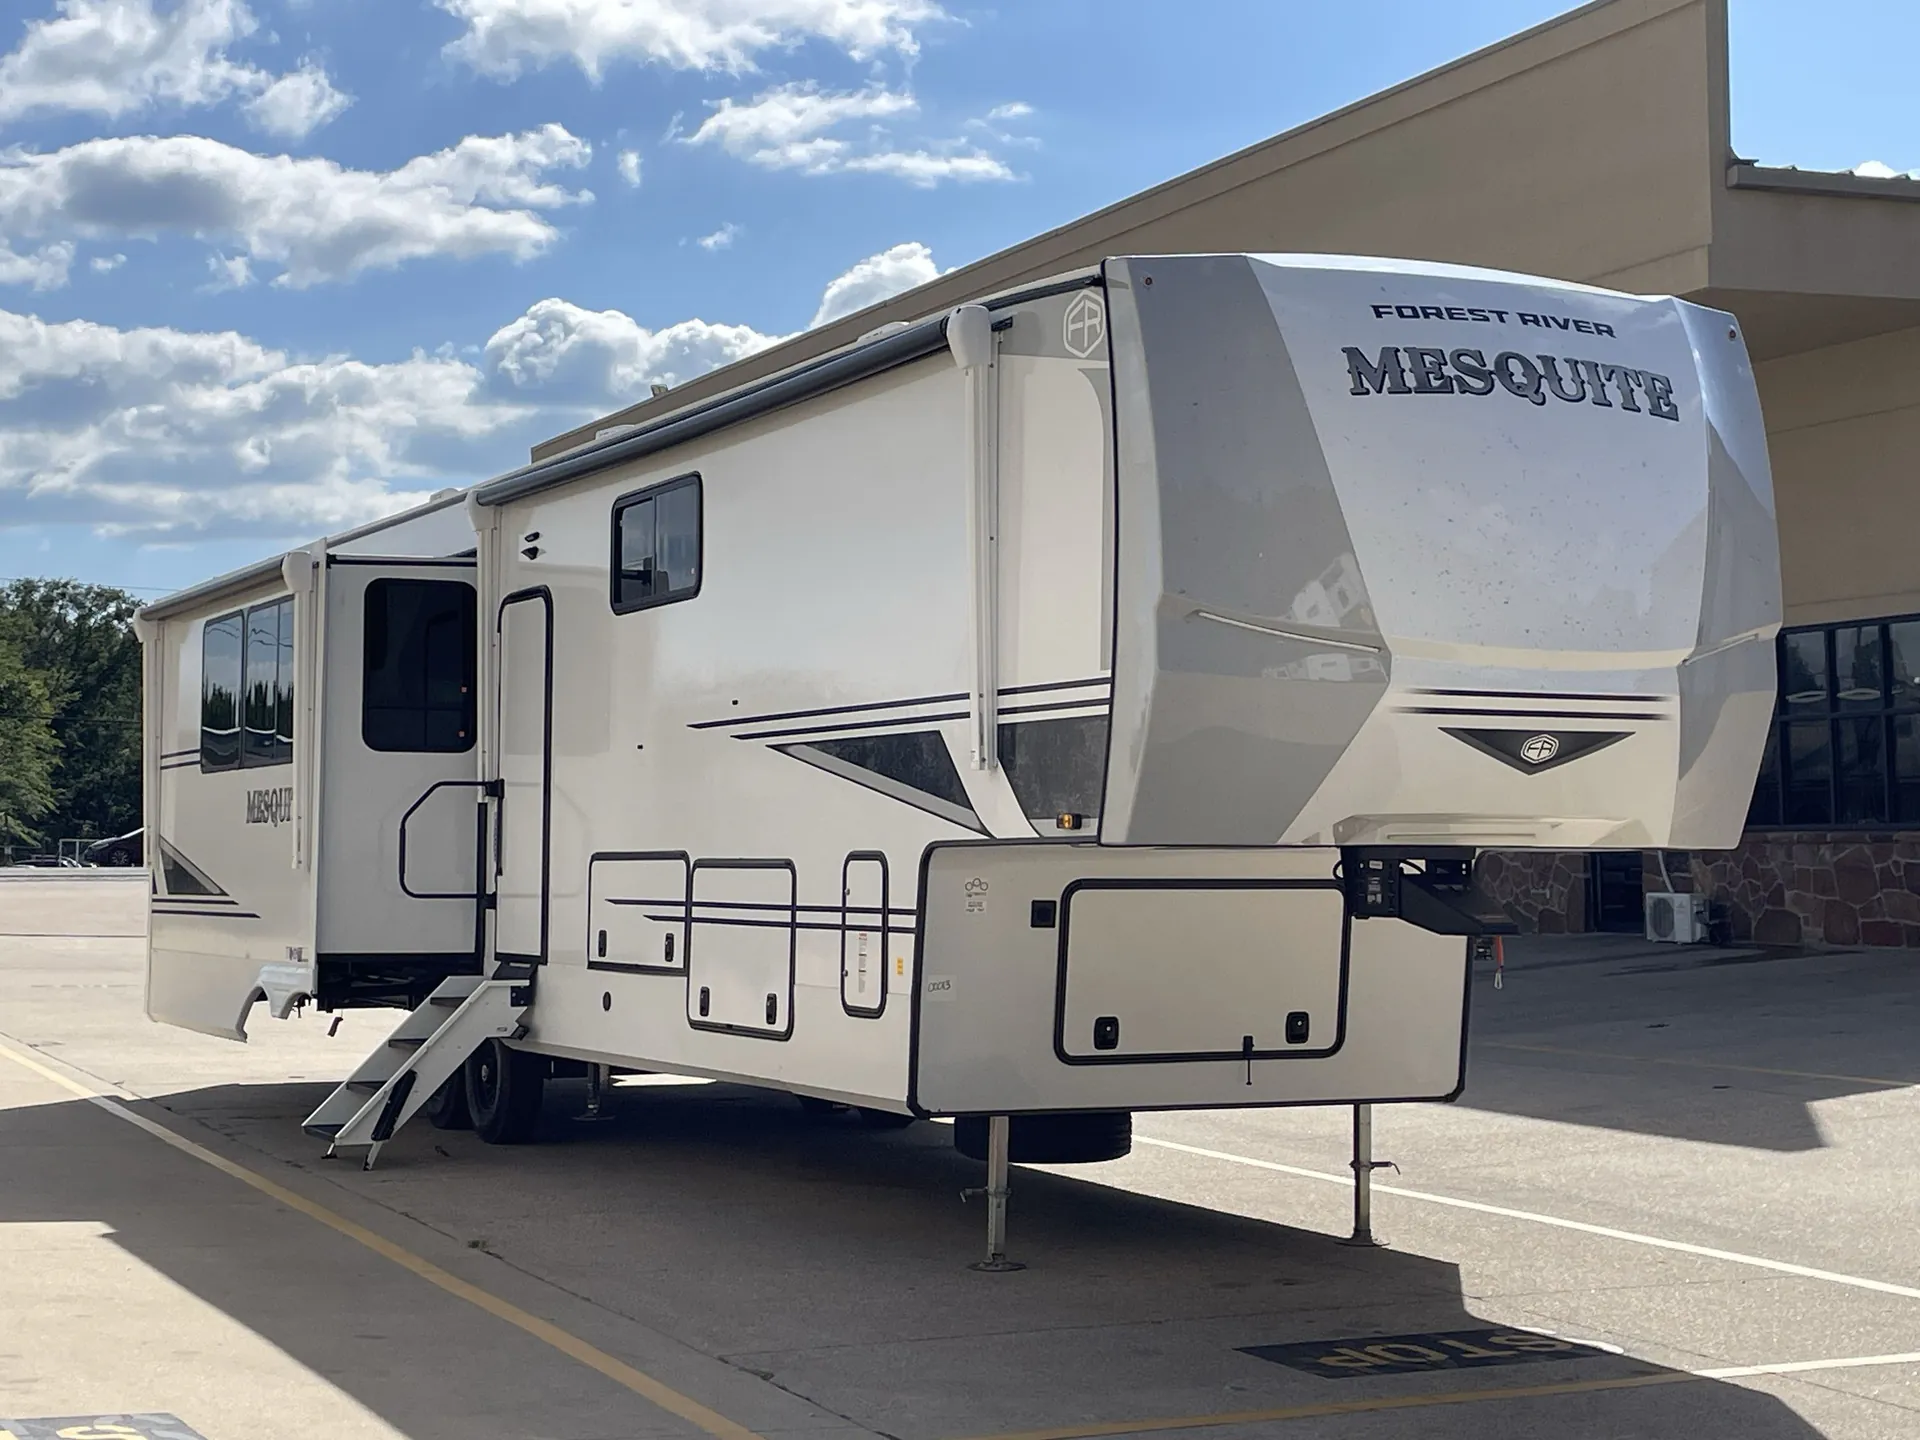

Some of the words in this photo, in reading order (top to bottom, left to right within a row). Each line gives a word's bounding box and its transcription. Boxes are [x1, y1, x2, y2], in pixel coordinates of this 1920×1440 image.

[1370, 304, 1510, 324] FOREST
[1516, 311, 1617, 338] RIVER
[1341, 346, 1680, 422] MESQUITE
[1317, 1335, 1573, 1368] STOP
